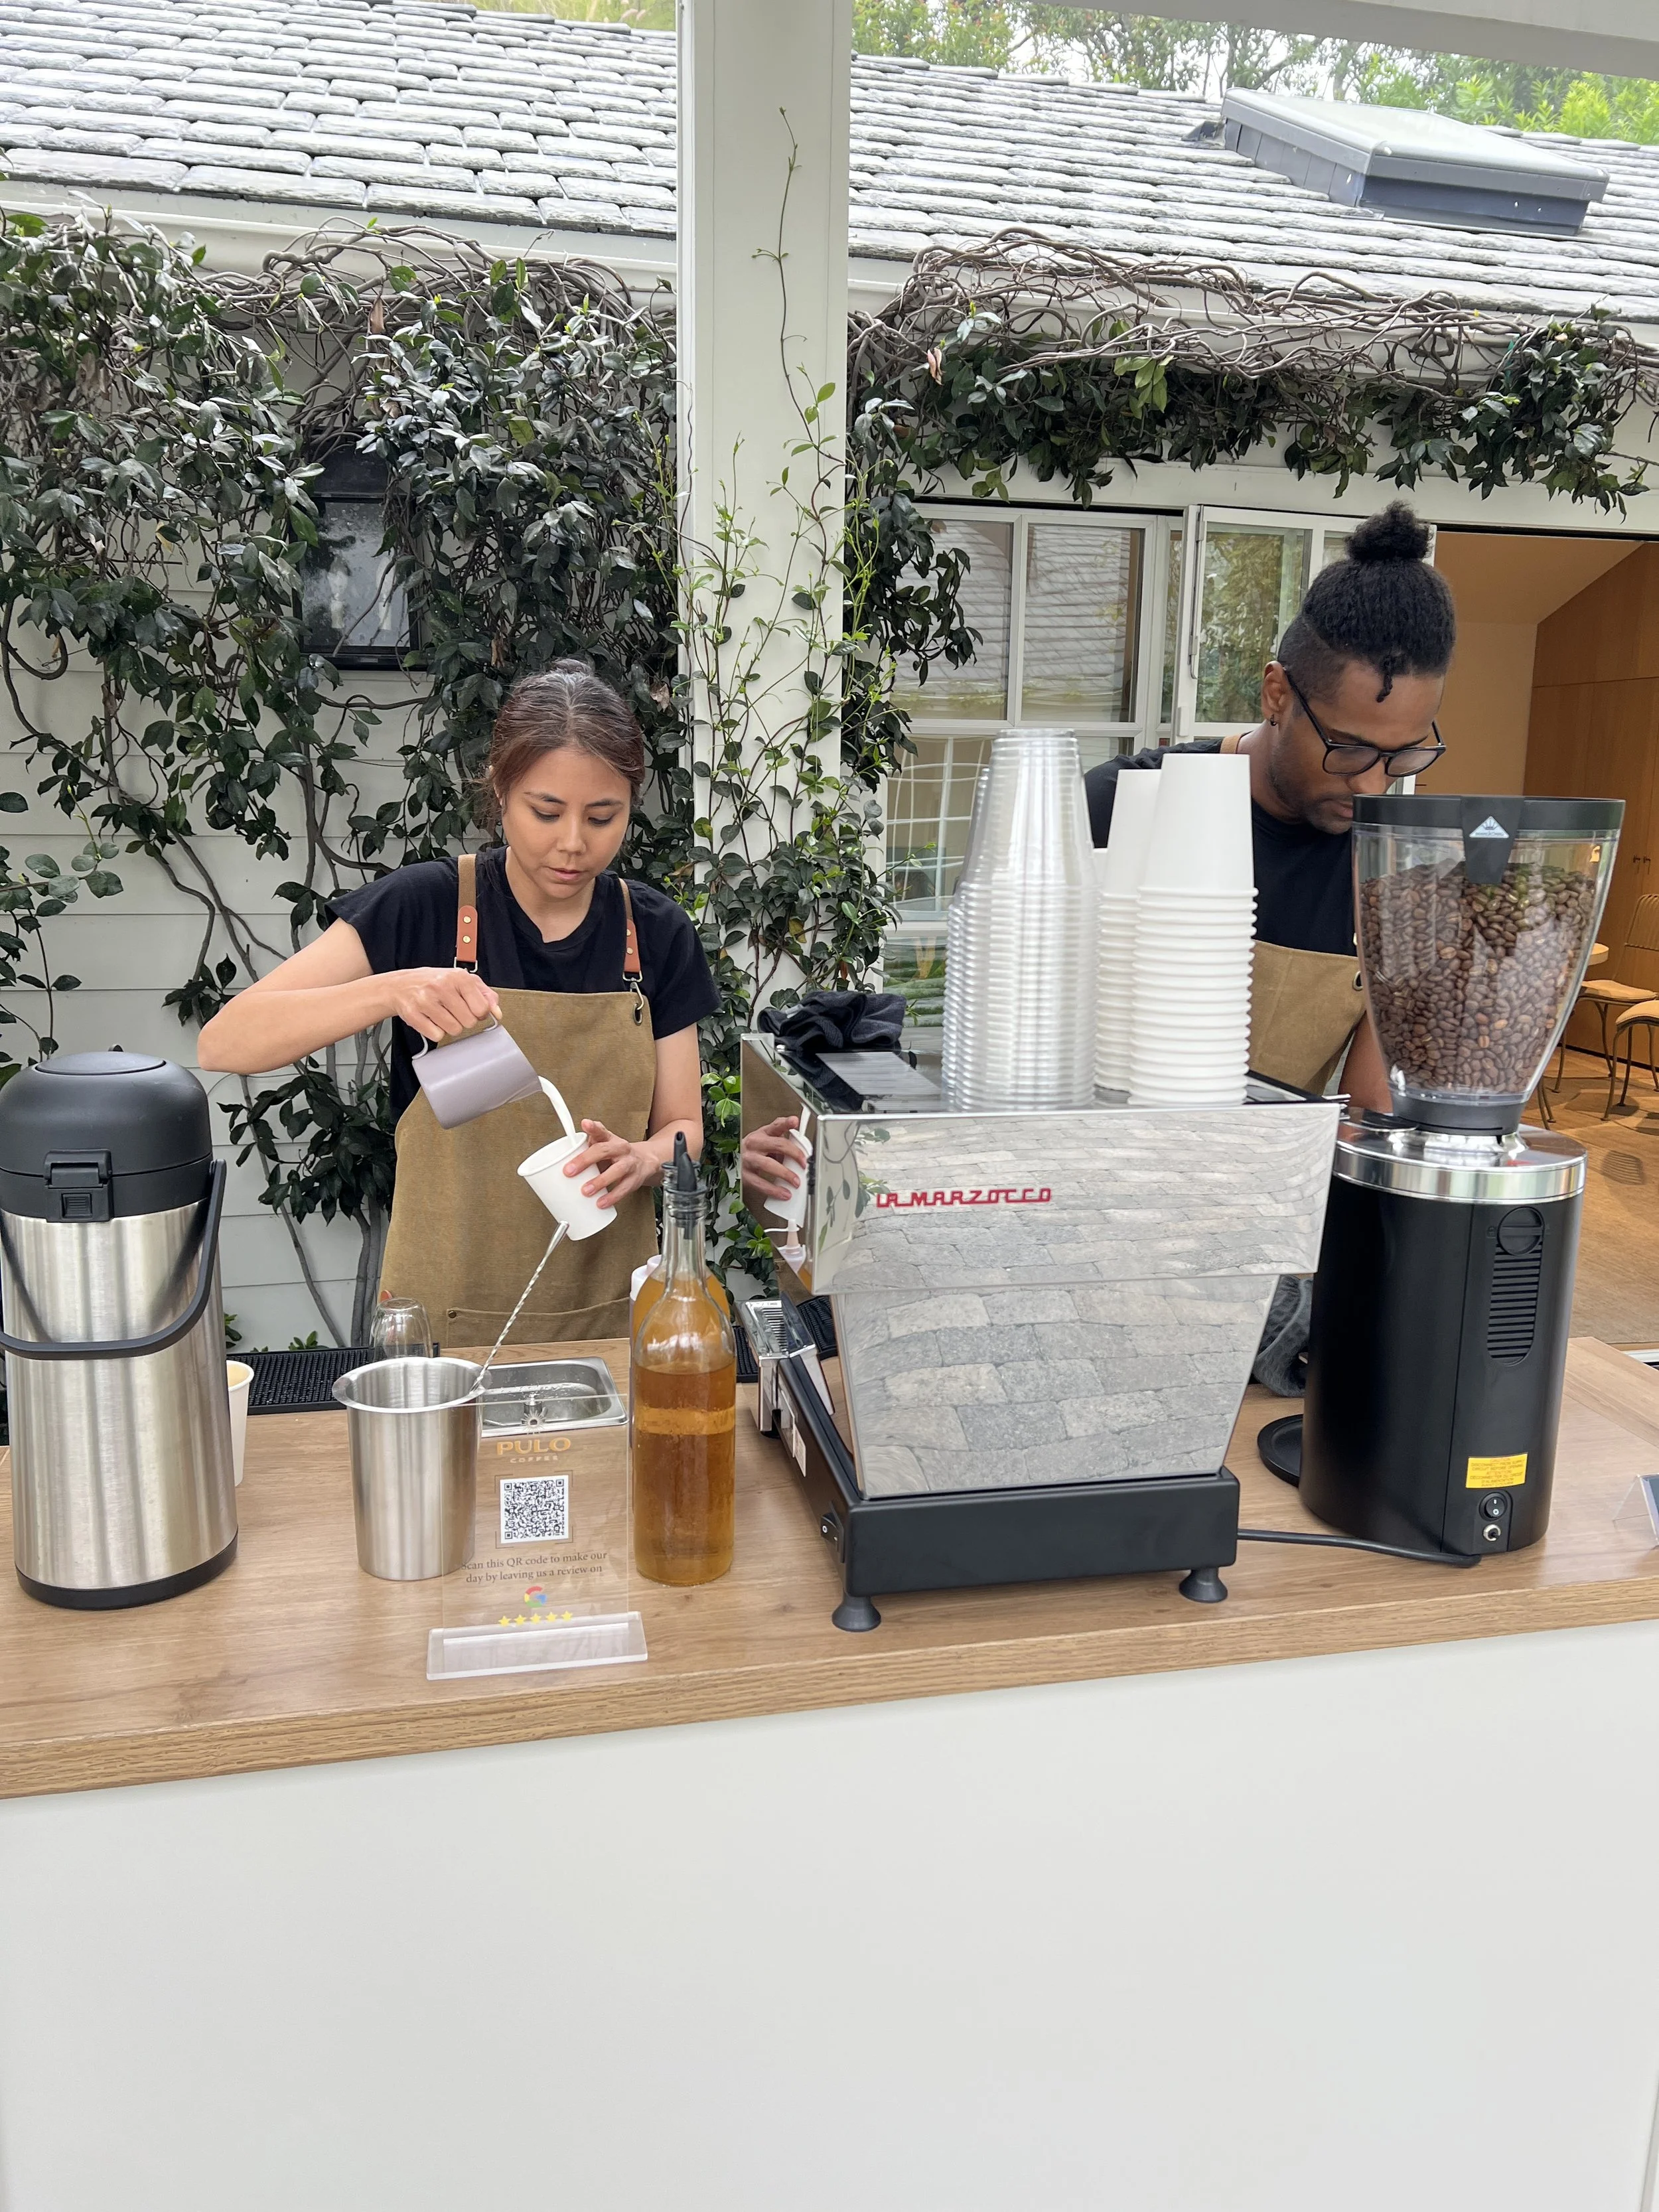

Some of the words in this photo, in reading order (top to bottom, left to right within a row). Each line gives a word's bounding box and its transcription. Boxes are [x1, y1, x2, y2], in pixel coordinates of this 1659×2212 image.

[876, 1193, 898, 1208] LA
[910, 1188, 1052, 1206] MARZOCCO
[496, 1437, 571, 1455] PULO
[486, 1559, 504, 1568] this
[506, 1558, 523, 1567] QR
[525, 1556, 548, 1565] code
[563, 1552, 589, 1562] make
[466, 1574, 483, 1584] day
[486, 1572, 498, 1584] by
[500, 1570, 534, 1580] leaving
[557, 1566, 588, 1576] review
